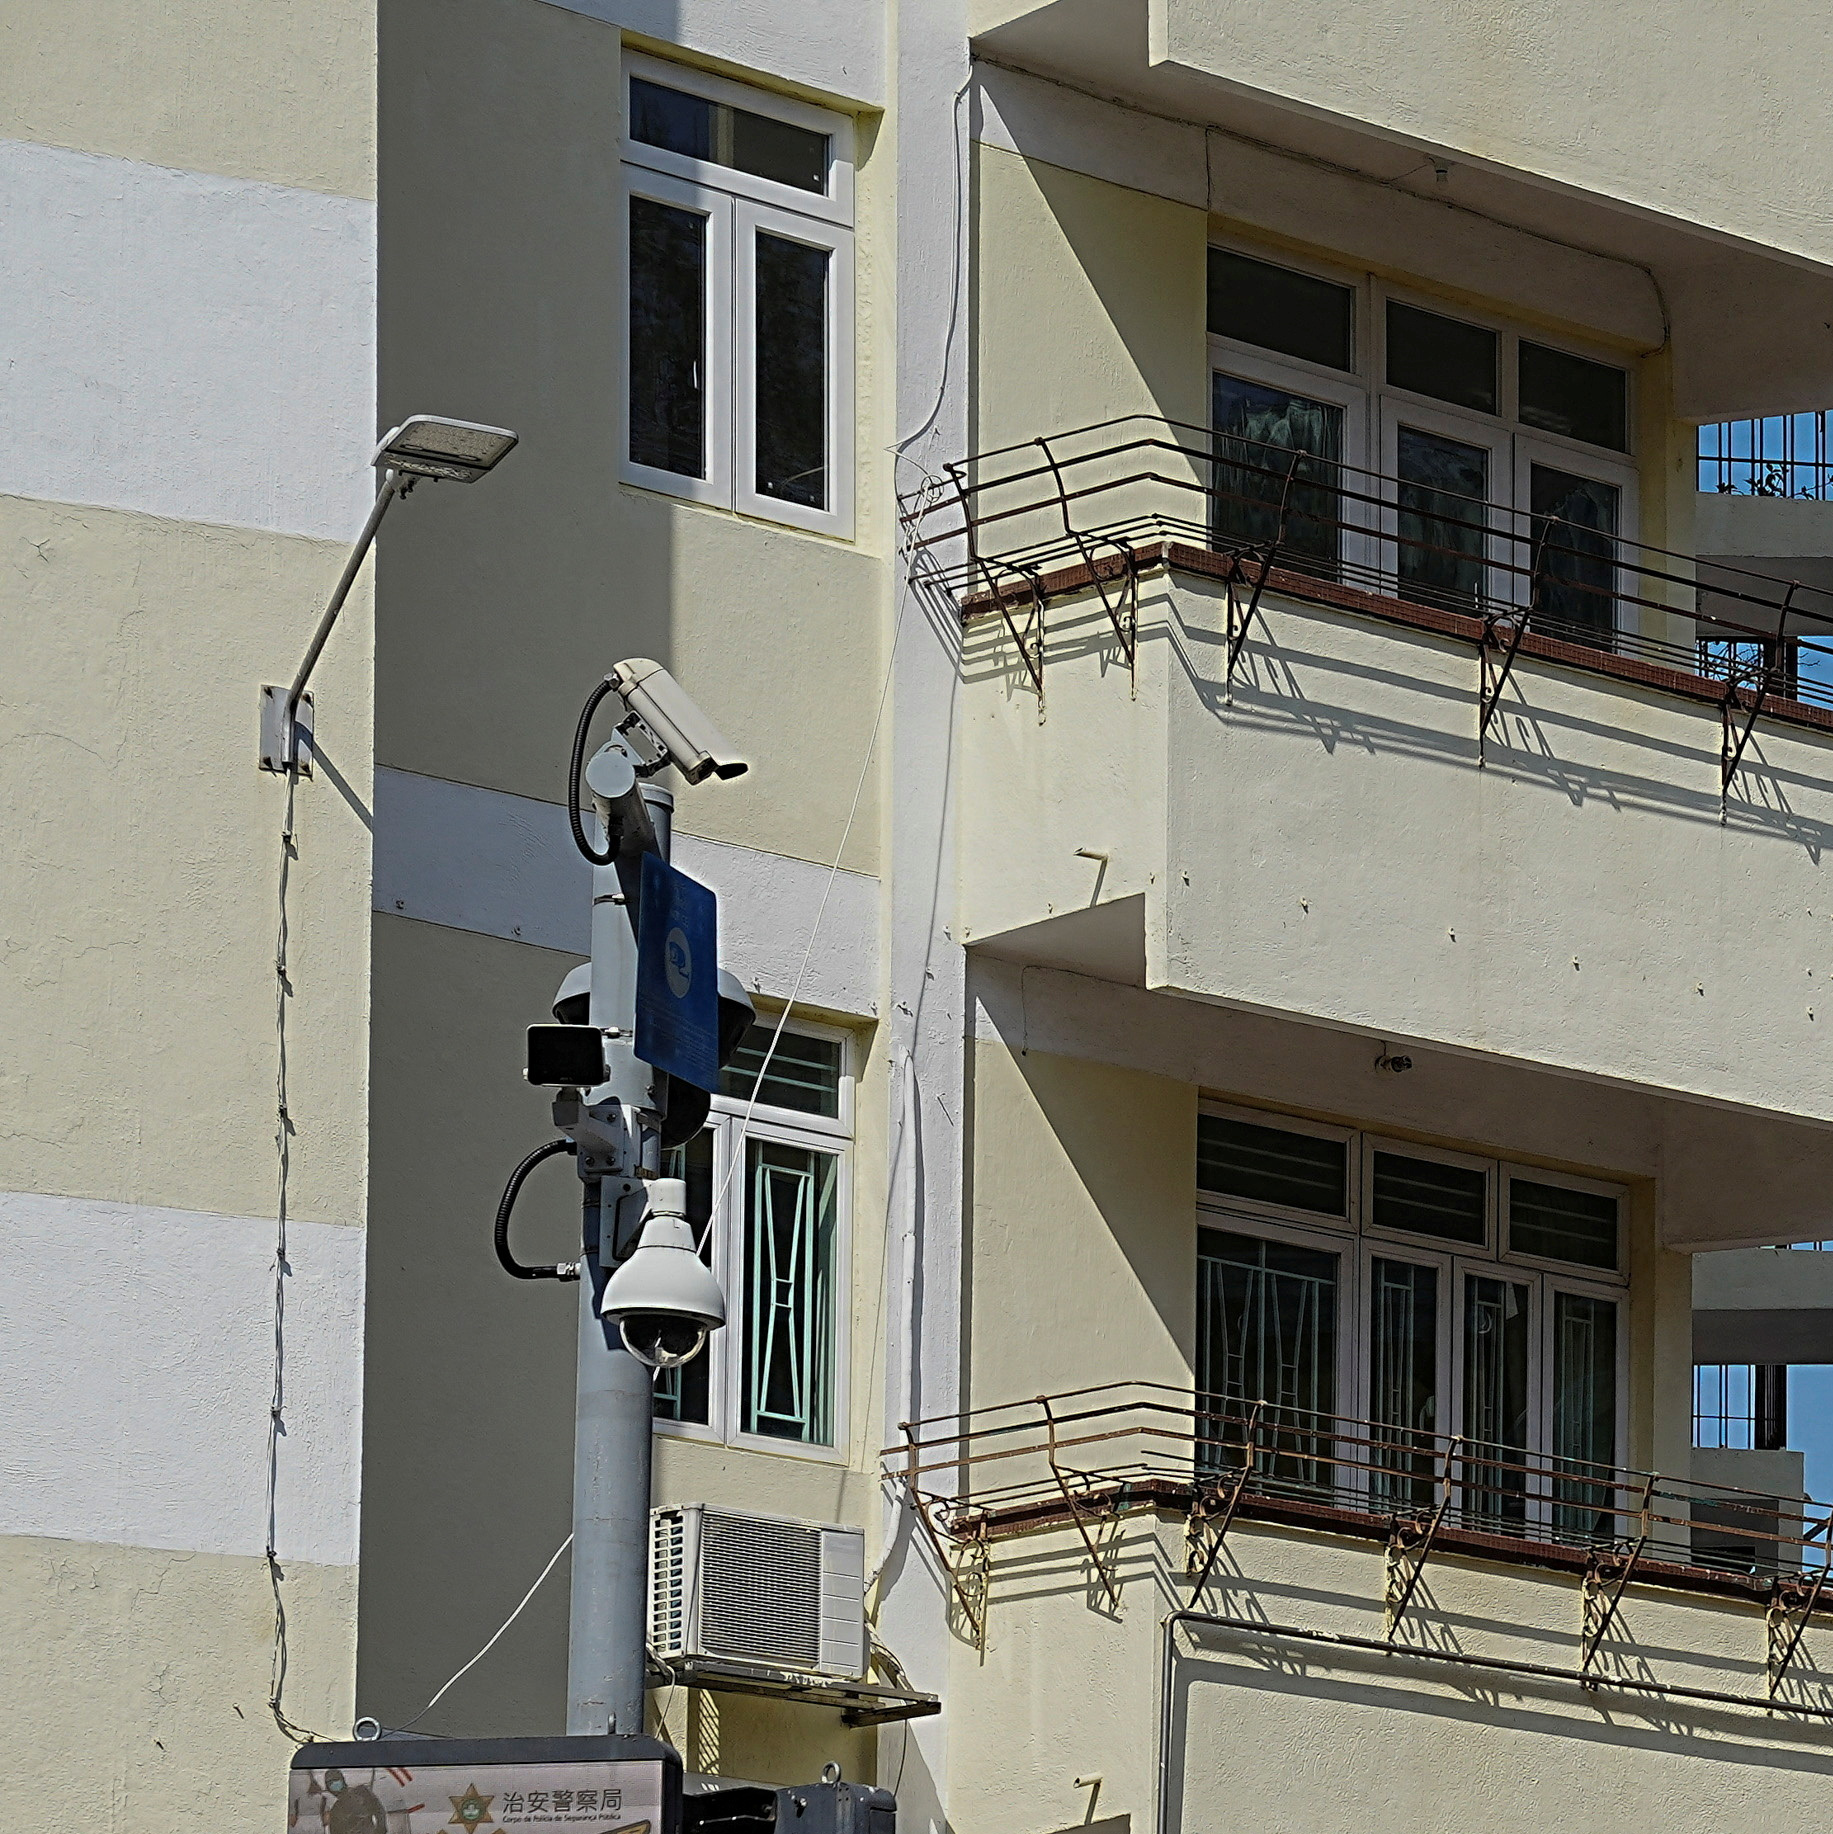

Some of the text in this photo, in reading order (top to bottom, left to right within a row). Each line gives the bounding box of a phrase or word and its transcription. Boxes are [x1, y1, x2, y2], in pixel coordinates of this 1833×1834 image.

[504, 1789, 622, 1813] 治安警察局
